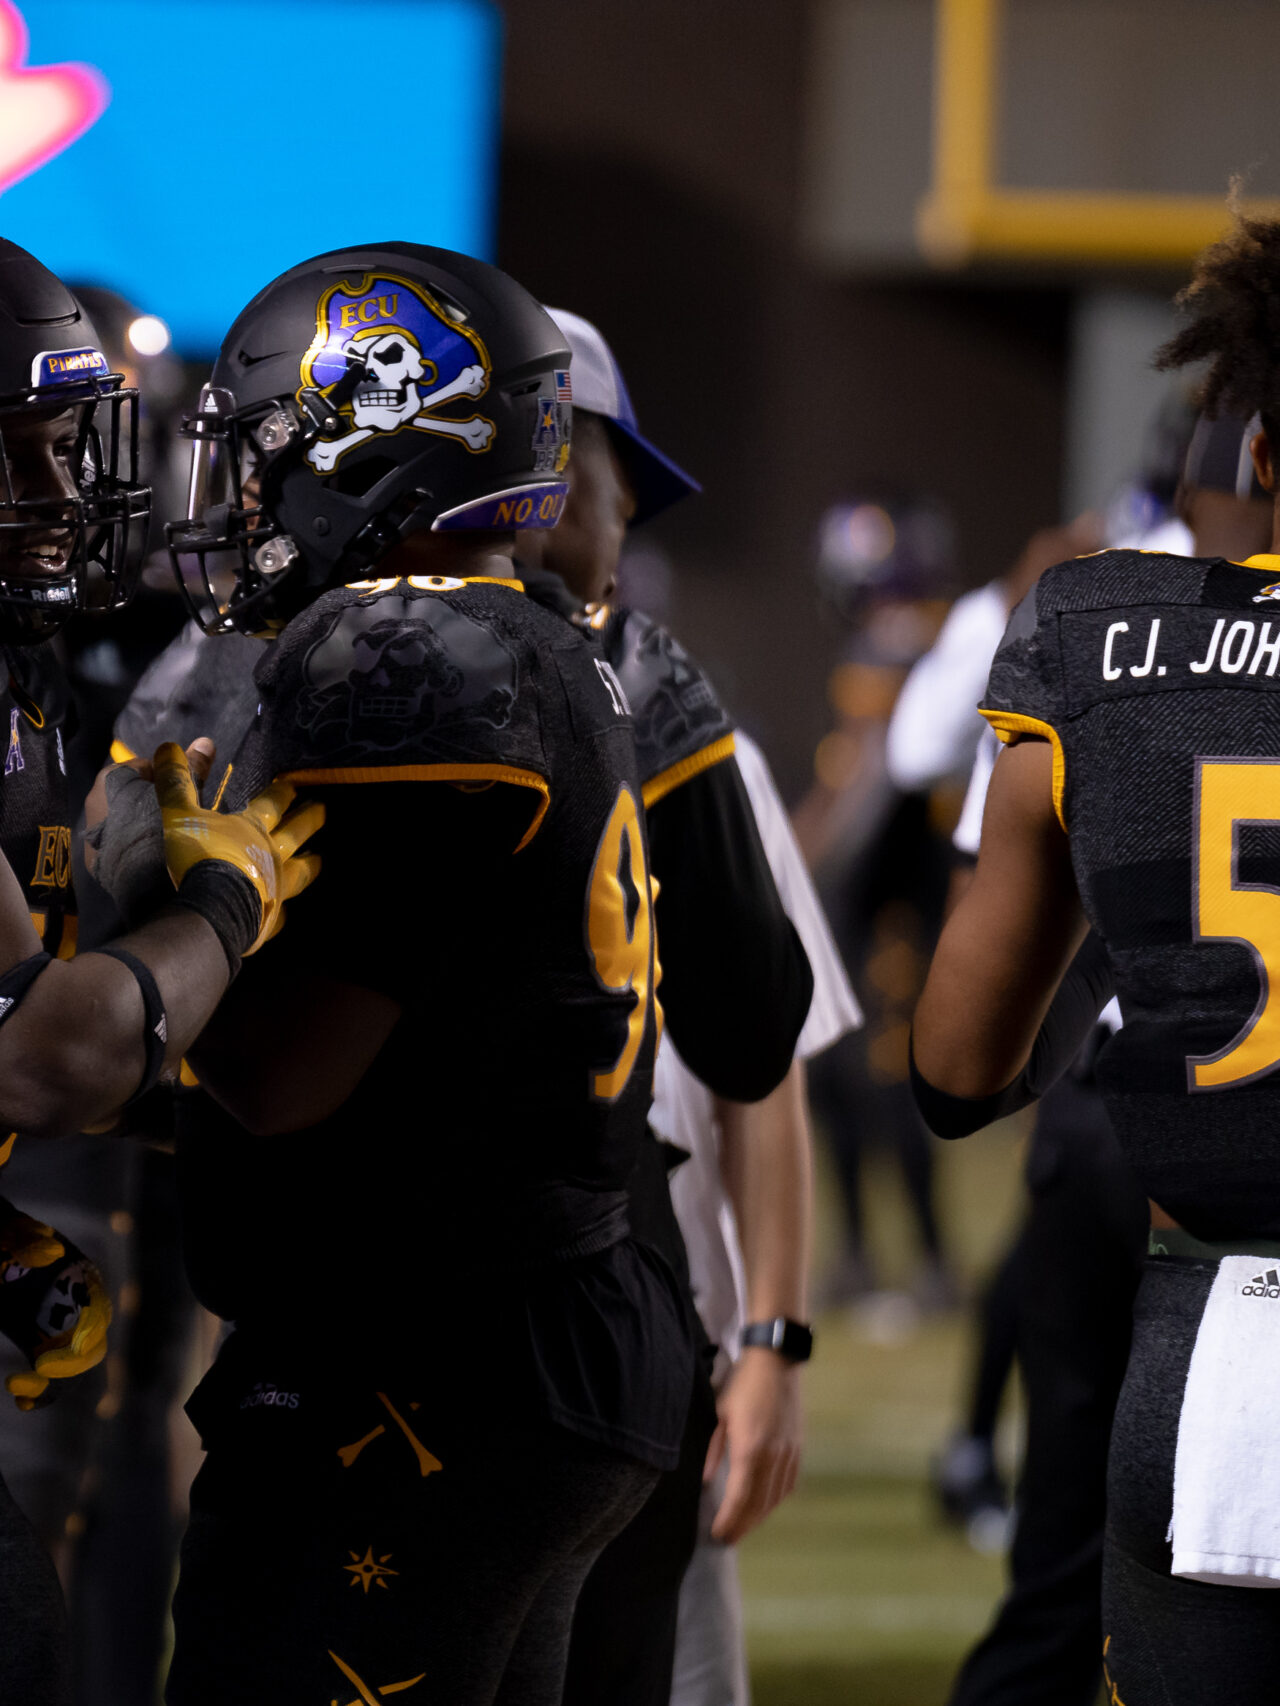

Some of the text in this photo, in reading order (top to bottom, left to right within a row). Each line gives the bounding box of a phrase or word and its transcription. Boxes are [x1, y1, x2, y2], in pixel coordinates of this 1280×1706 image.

[338, 294, 399, 329] ECU
[492, 497, 533, 526] NO
[239, 1391, 301, 1410] adidas
